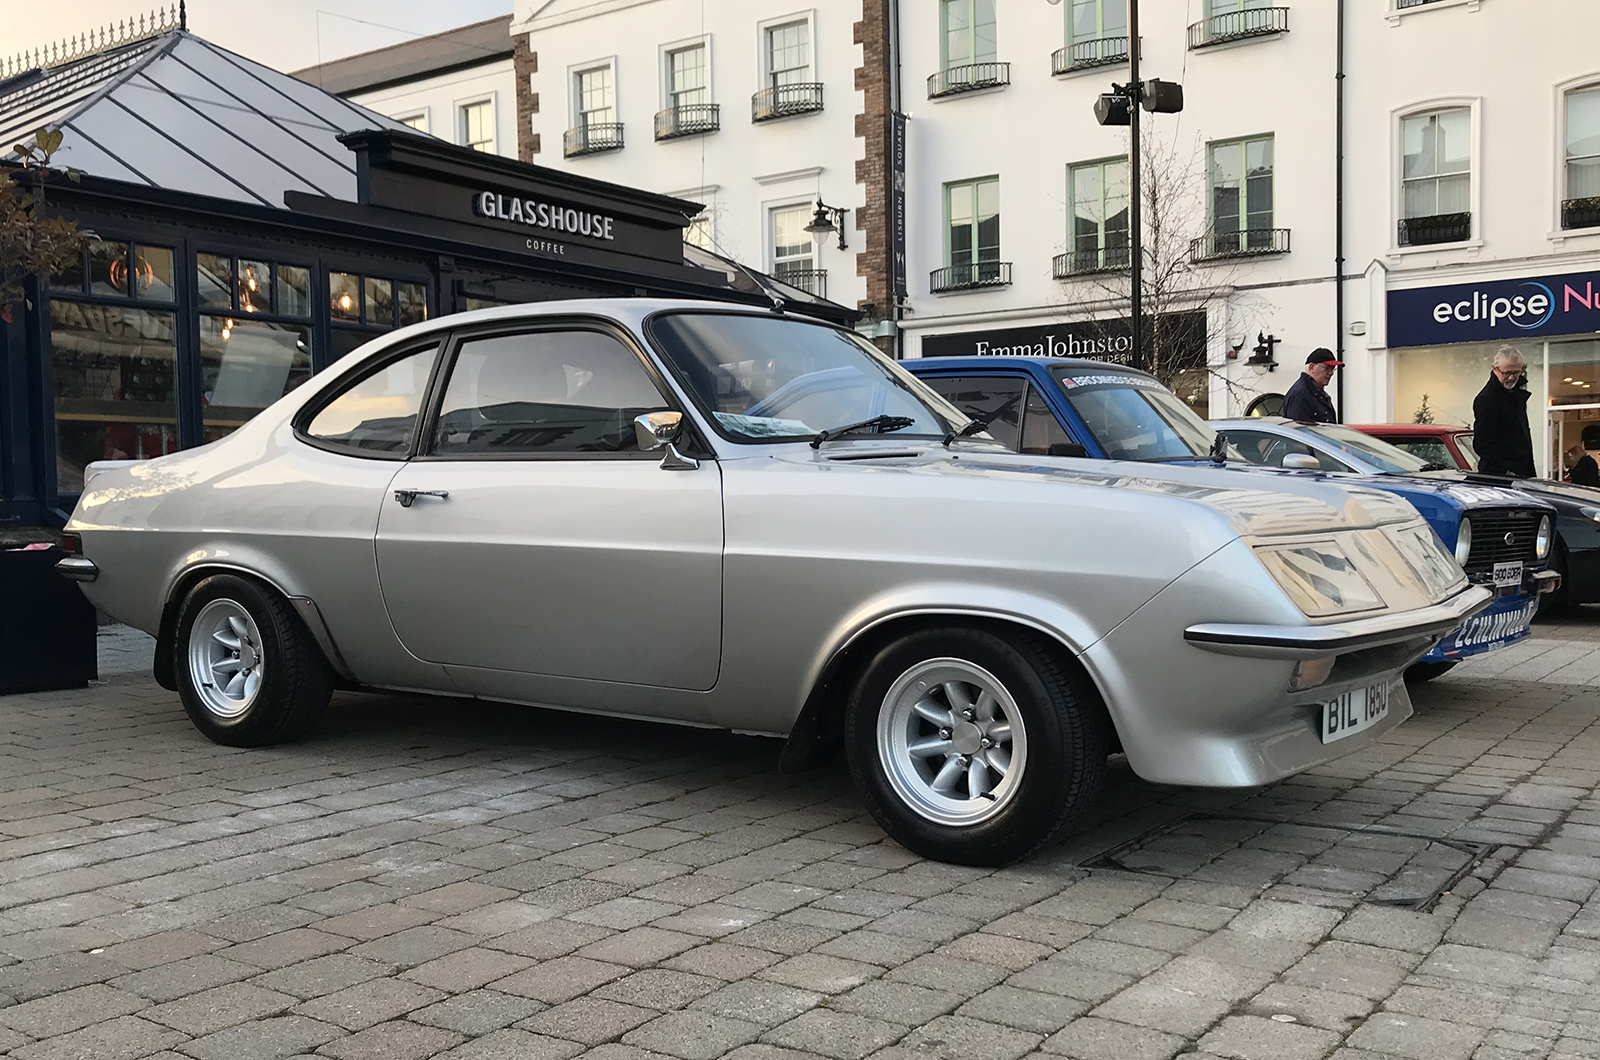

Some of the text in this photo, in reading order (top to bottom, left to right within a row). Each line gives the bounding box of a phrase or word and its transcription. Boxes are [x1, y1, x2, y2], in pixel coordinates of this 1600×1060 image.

[480, 190, 615, 241] GLASSHOUSE
[526, 238, 565, 256] COFFEE
[1433, 290, 1549, 328] eclipse
[1328, 691, 1358, 734] BIL
